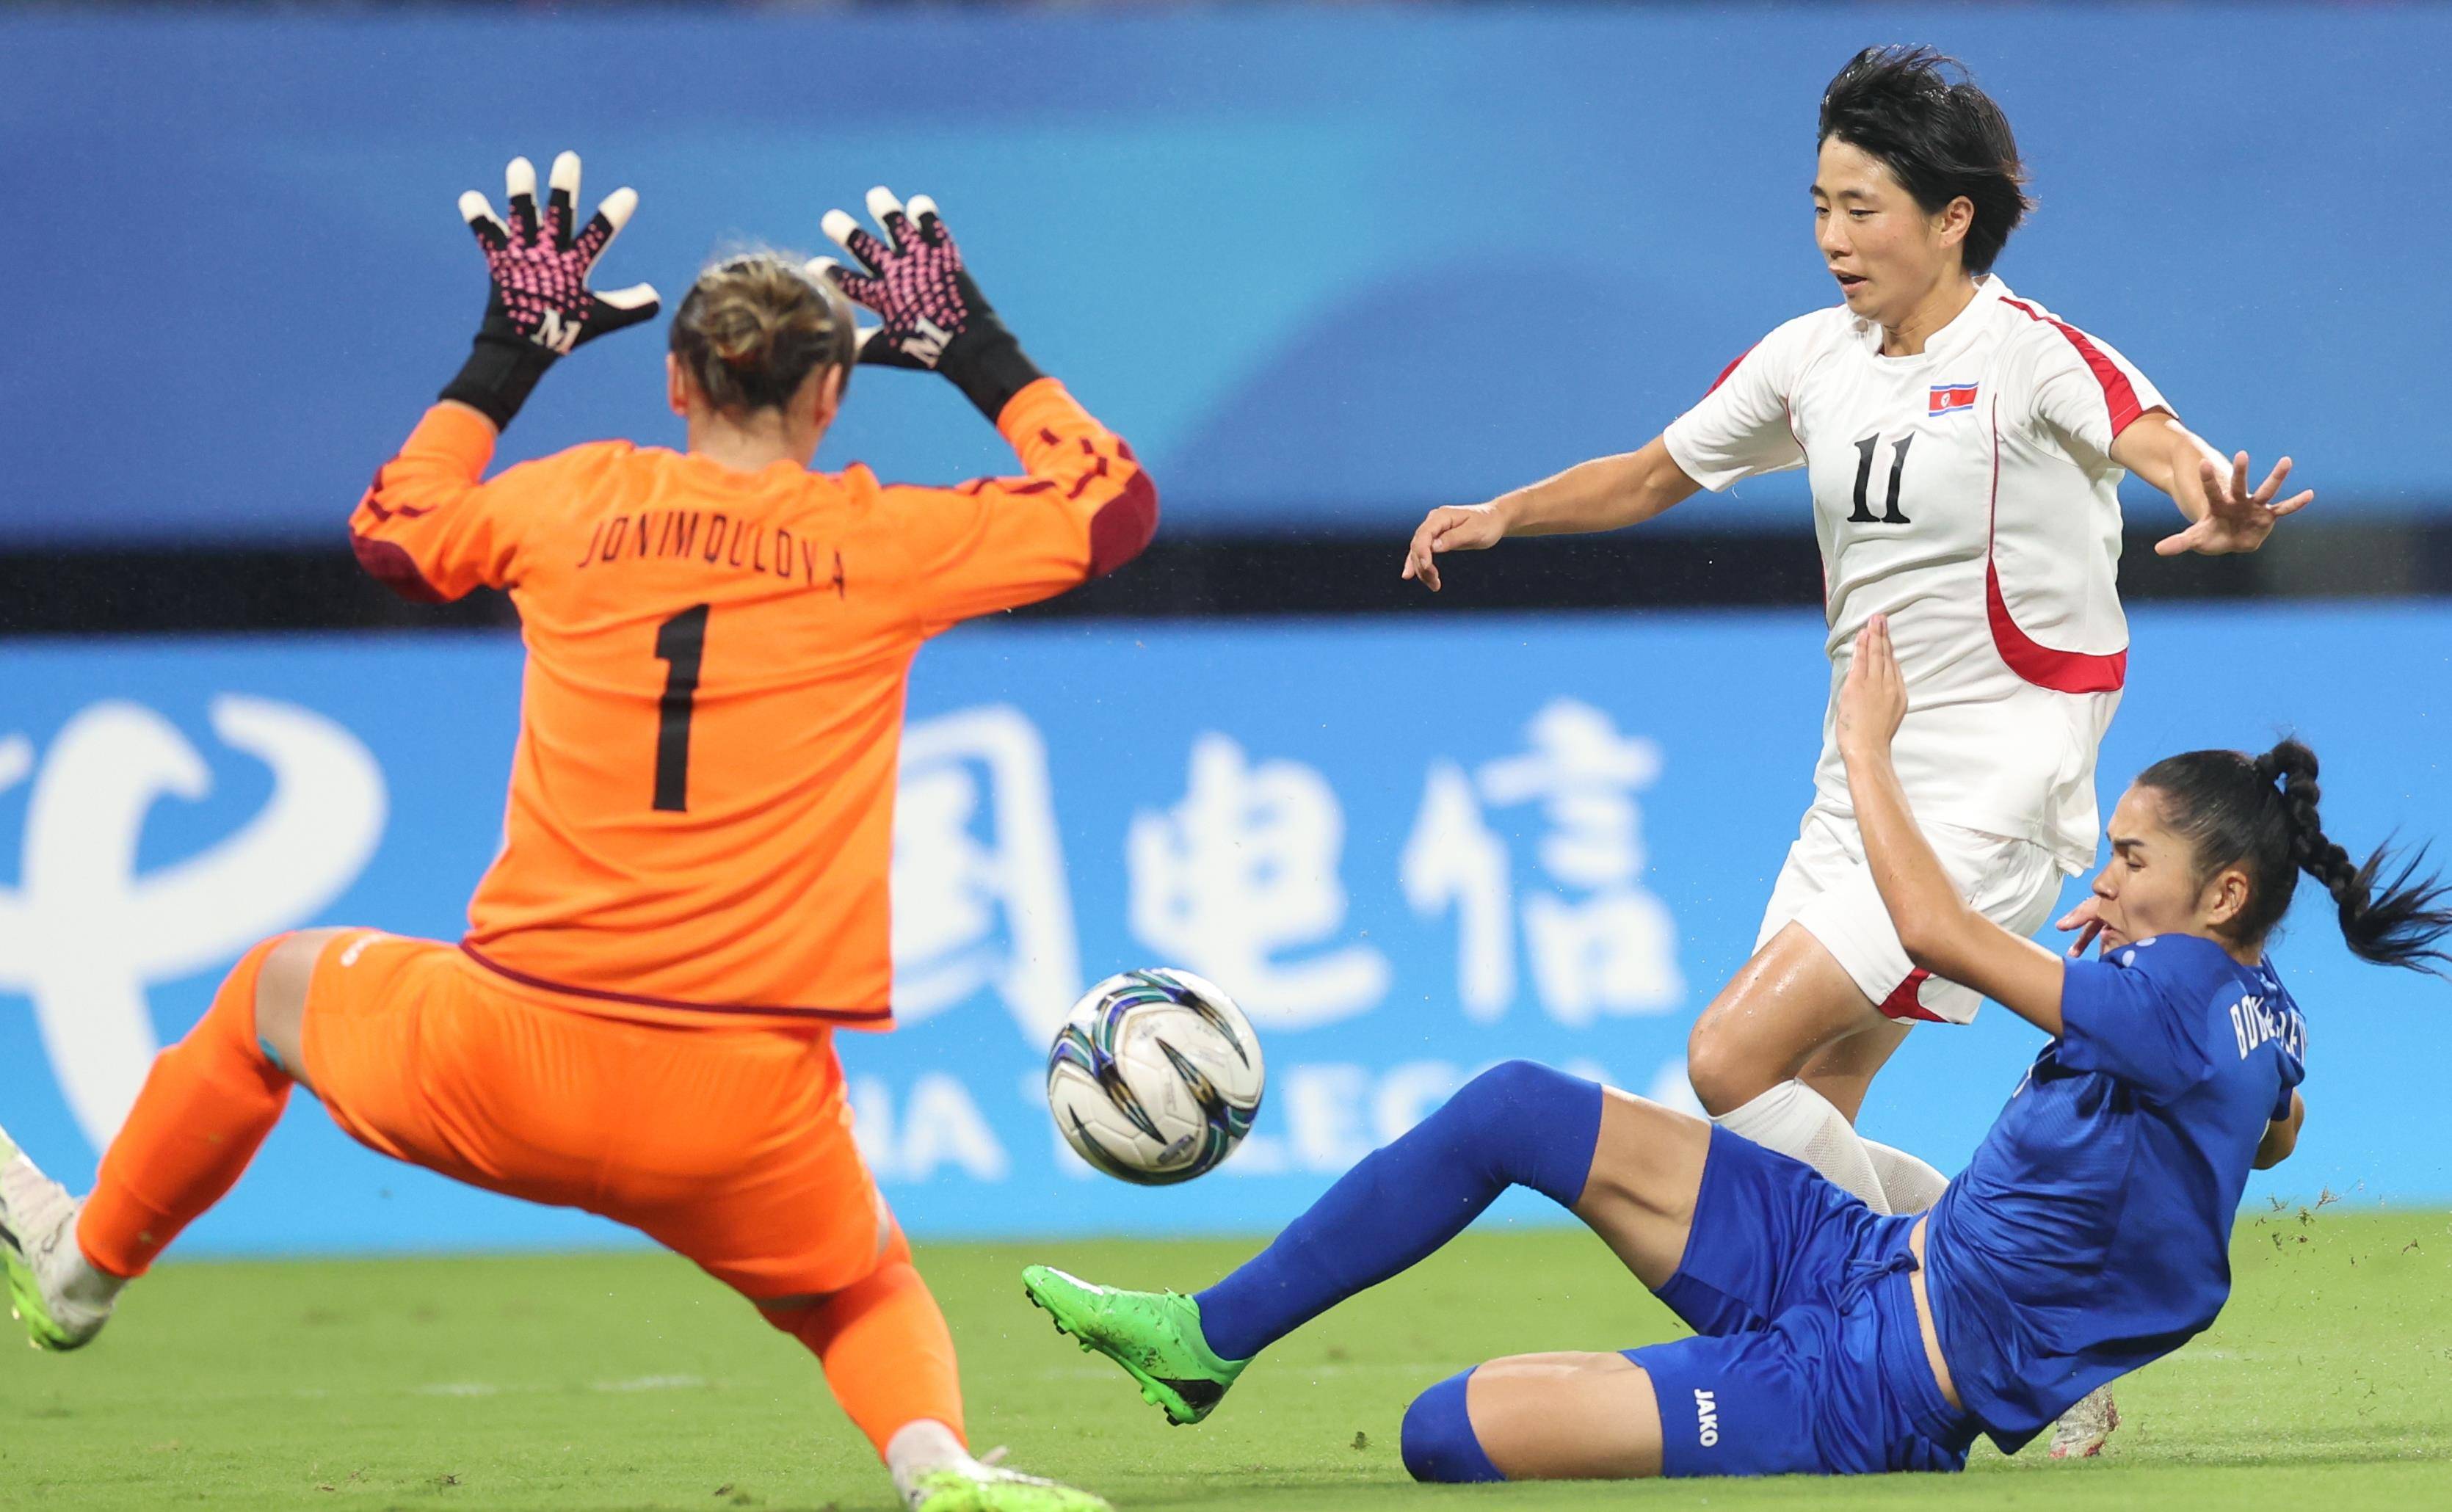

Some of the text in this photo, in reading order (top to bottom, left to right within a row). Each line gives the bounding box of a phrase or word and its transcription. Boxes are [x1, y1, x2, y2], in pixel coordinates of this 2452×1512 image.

[1847, 431, 1915, 523] 11
[651, 603, 710, 813] 1
[1694, 1389, 1719, 1447] JAKO
